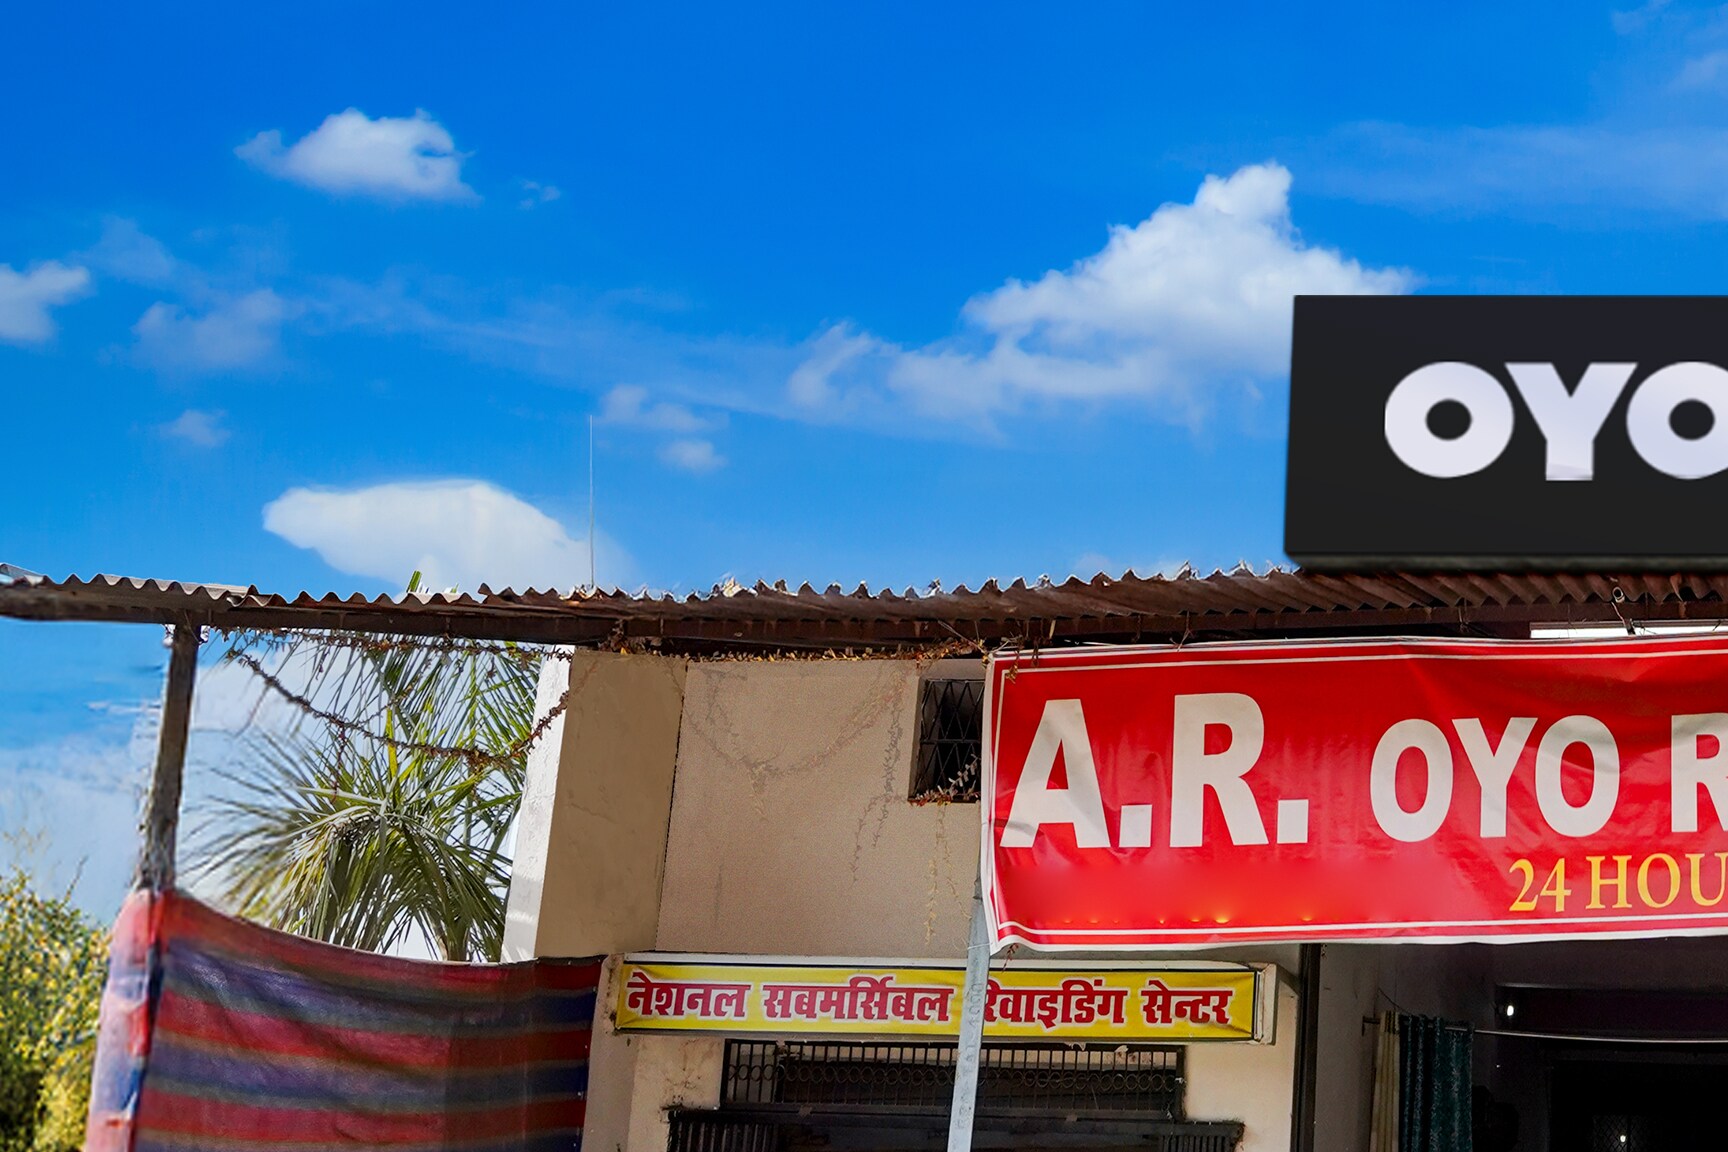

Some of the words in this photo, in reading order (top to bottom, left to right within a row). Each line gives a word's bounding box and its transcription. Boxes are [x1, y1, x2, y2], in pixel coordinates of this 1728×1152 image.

[999, 692, 1309, 849] A.R.
[1369, 714, 1620, 843] OYO
[1508, 857, 1572, 912] 24
[626, 972, 751, 1018] नेशनल
[762, 976, 954, 1022] सबमर्सिबल
[1140, 979, 1232, 1025] सेन्टर
